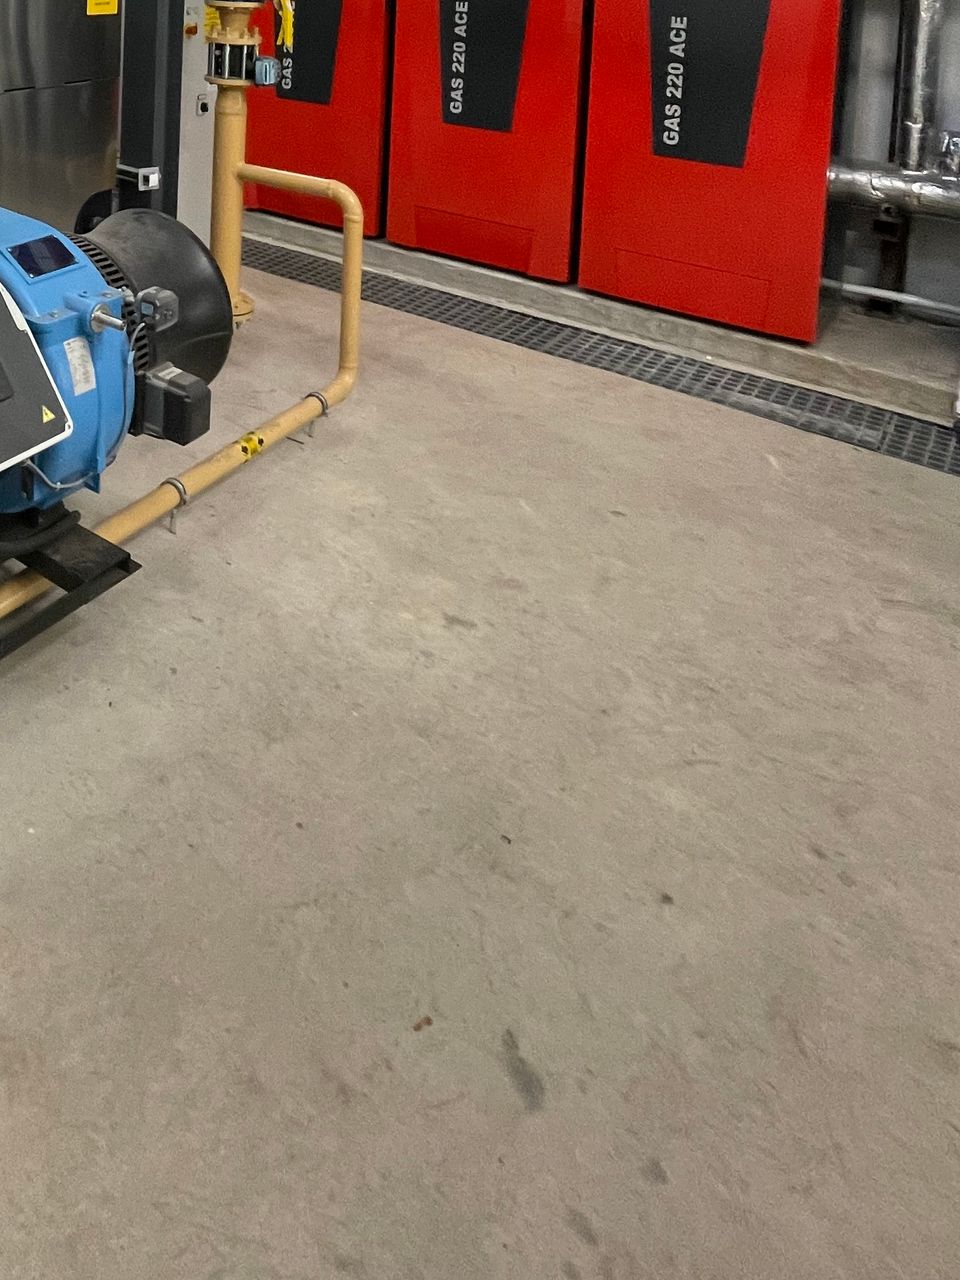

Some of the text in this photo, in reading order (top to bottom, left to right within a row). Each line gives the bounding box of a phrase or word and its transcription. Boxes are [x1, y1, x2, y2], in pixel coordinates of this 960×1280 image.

[281, 57, 293, 90] GAS
[450, 1, 469, 114] GAS 220 ACE
[663, 16, 688, 146] GAS 220 ACE
